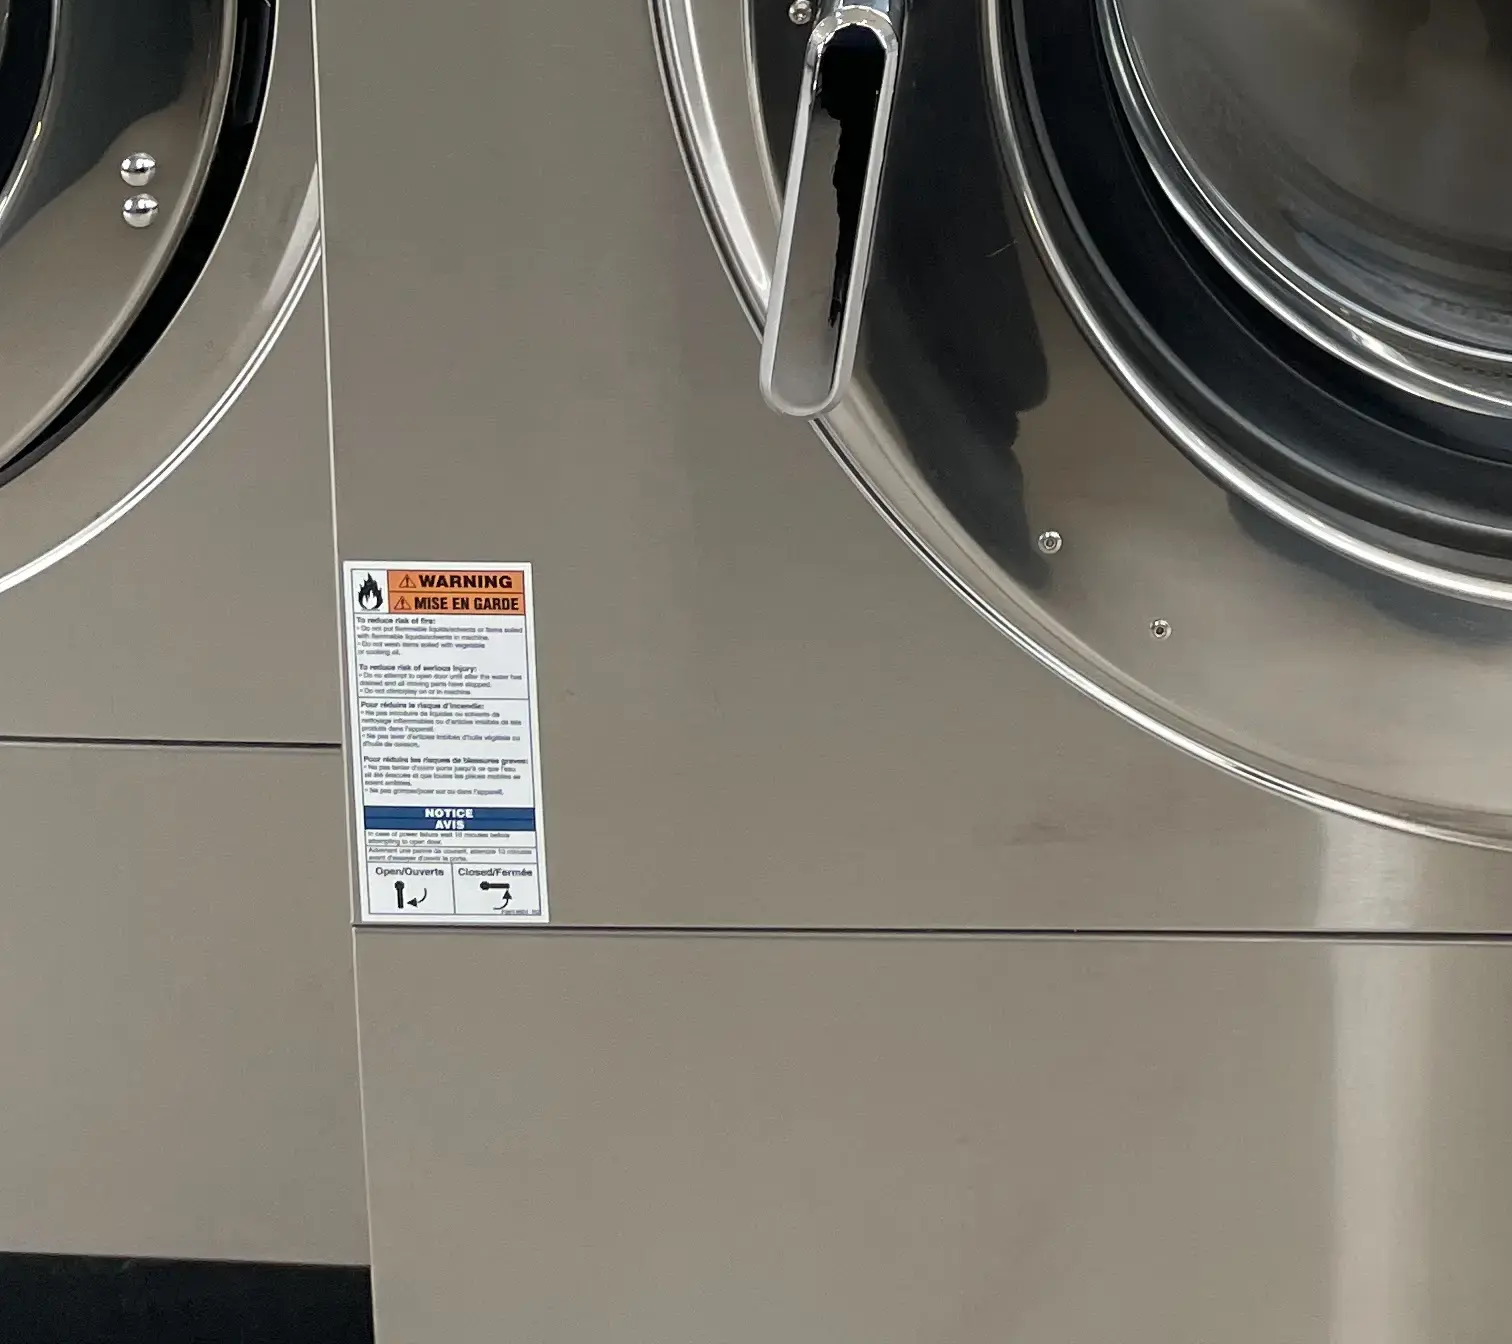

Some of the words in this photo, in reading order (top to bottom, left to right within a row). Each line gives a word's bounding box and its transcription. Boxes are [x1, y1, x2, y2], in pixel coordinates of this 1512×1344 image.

[419, 575, 512, 588] WARNING
[415, 597, 448, 610] MISE
[452, 598, 469, 610] EN
[474, 598, 519, 610] GARDE
[425, 809, 473, 818] NOTICE
[435, 820, 465, 830] AVIS
[375, 867, 444, 876] Open/Ouverte
[458, 868, 533, 876] Closed/Fermée
